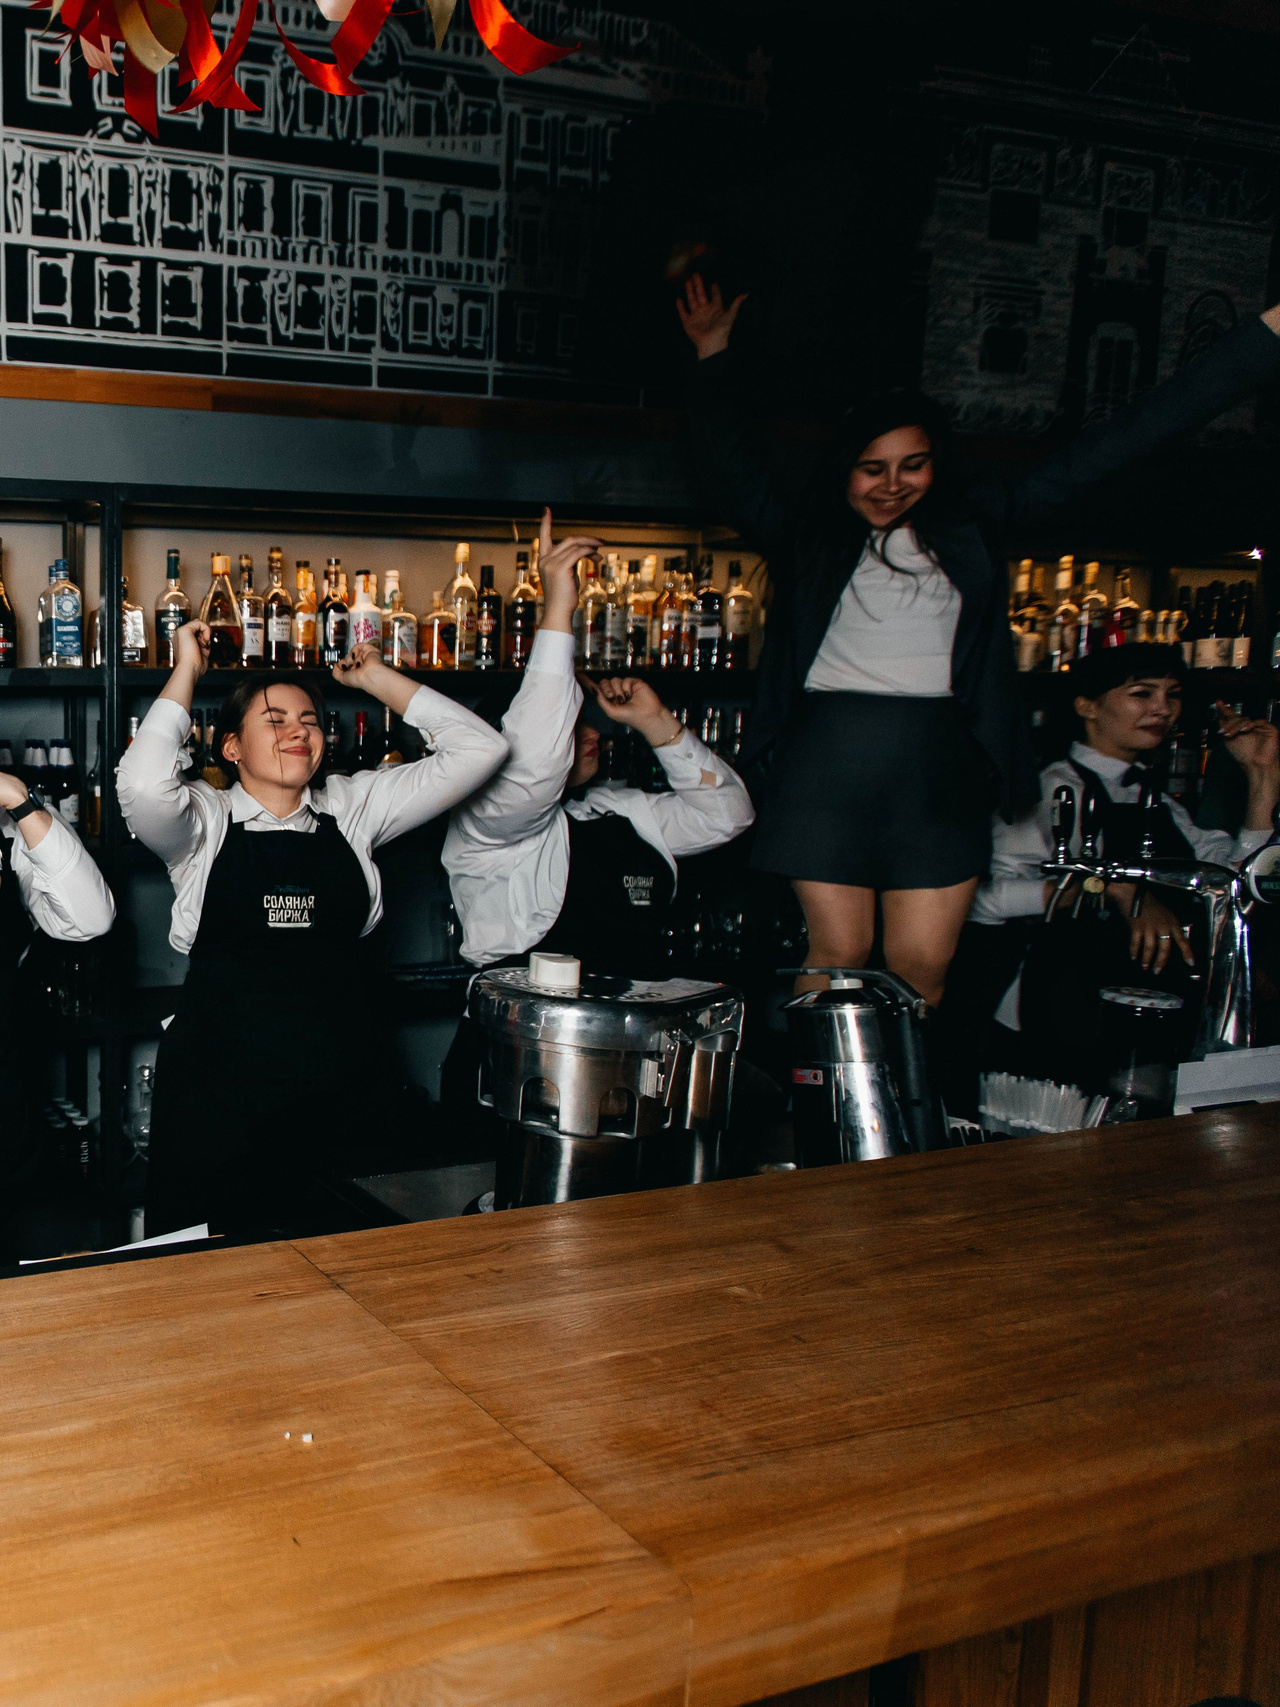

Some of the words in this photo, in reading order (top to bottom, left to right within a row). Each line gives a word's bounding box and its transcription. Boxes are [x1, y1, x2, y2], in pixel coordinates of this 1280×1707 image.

[263, 895, 315, 909] СОЛЯНАЯ
[268, 909, 309, 922] БИРЖА
[80, 1141, 89, 1162] Rich
